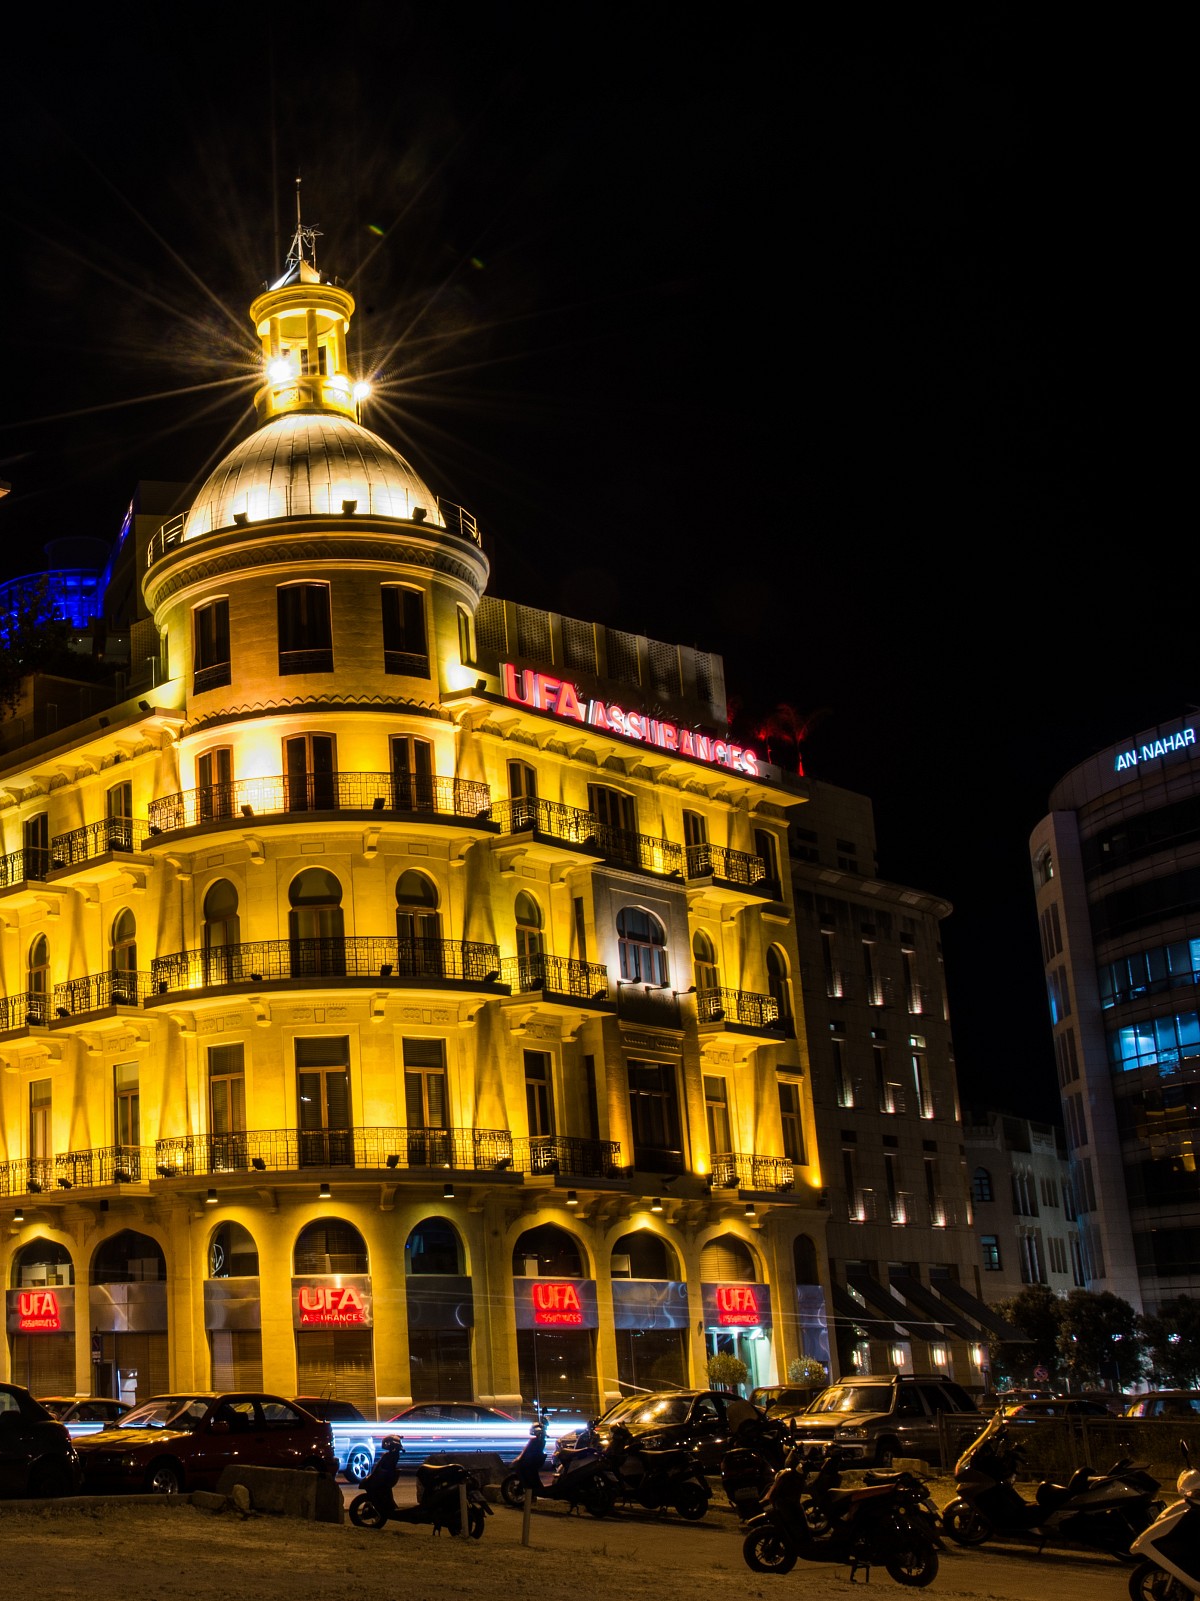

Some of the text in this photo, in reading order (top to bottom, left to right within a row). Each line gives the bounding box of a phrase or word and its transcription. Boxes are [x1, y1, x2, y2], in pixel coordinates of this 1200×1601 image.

[503, 662, 760, 777] UFA ASSURANCES
[1115, 728, 1197, 772] AN-NAHAR
[20, 1292, 56, 1316] UFA
[301, 1287, 363, 1310] UFA
[536, 1284, 580, 1310] UFA
[719, 1287, 757, 1311] UFA
[302, 1312, 365, 1322] ASSURANCES
